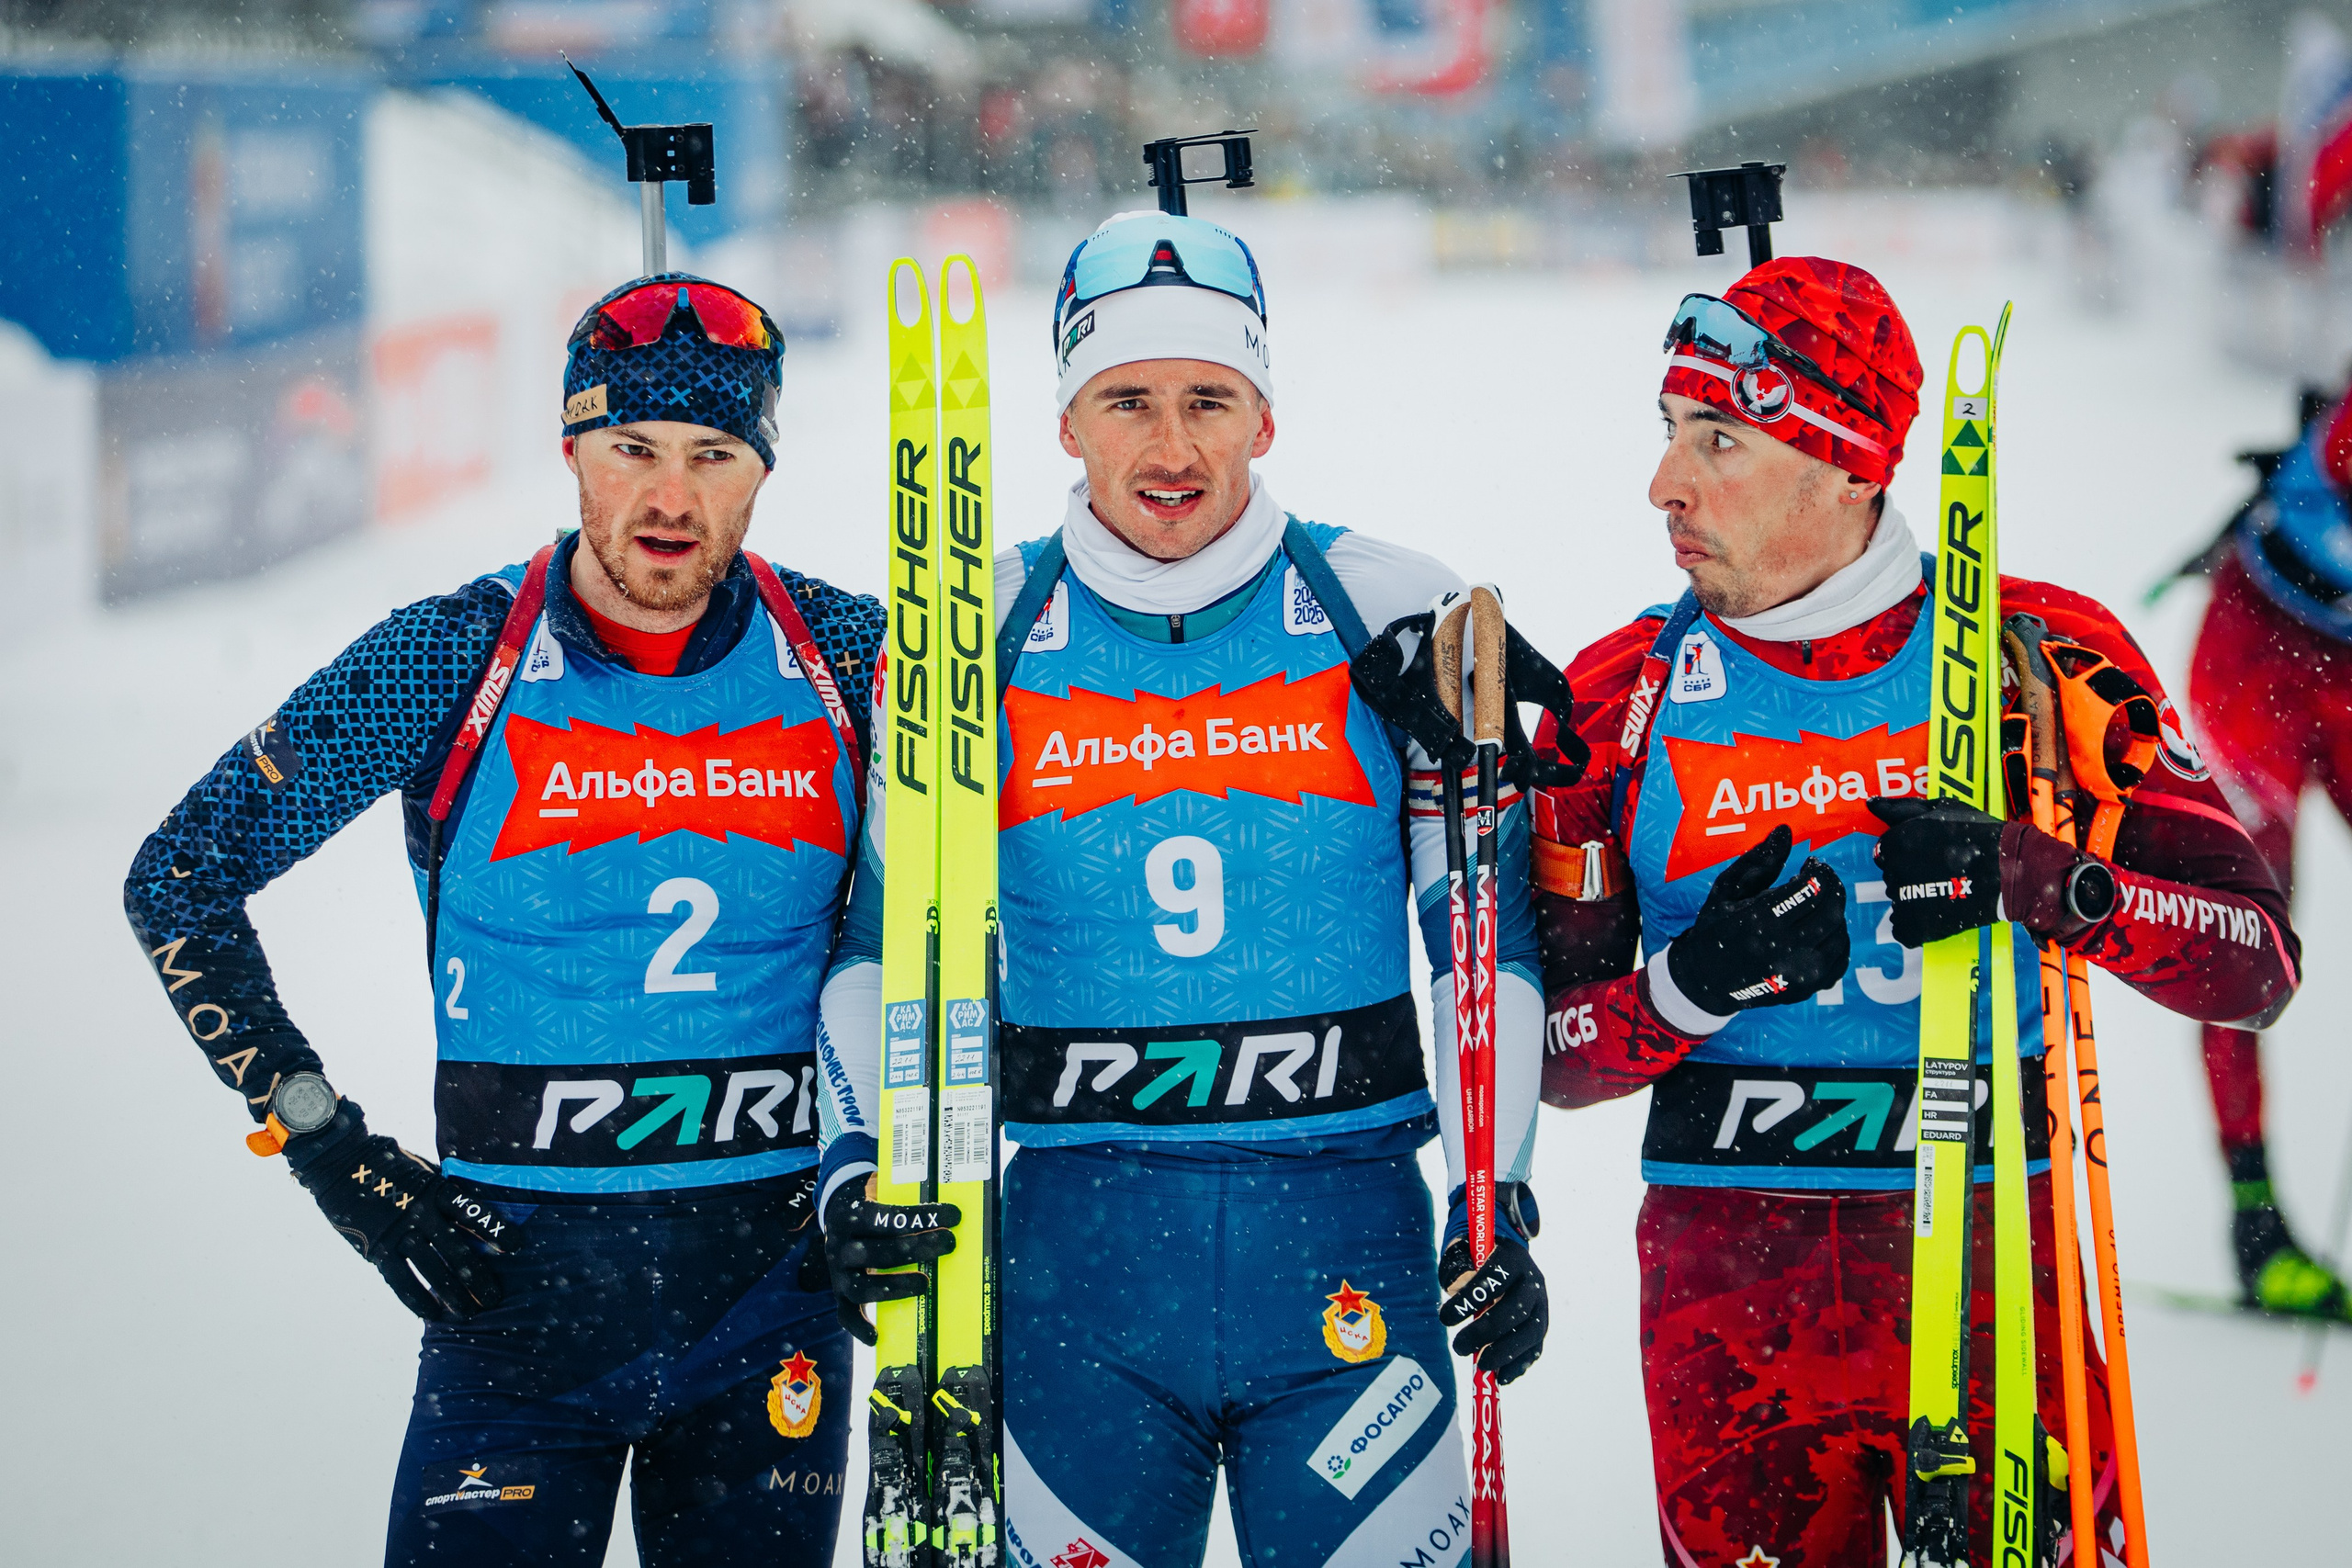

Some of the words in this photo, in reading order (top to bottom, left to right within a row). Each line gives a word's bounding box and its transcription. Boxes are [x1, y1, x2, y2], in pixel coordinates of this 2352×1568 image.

[1962, 402, 1977, 416] 2
[897, 438, 928, 795] FISCHER
[949, 436, 984, 795] FISCHER
[1294, 604, 1325, 625] 2025
[1030, 631, 1054, 642] СБР
[1683, 682, 1711, 693] СБР
[1035, 722, 1194, 772] Альфа
[1206, 717, 1329, 758] Банк
[258, 757, 279, 781] PRO
[541, 759, 696, 808] Альфа
[706, 759, 820, 798] Банк
[1708, 763, 1868, 819] Альфа
[1876, 758, 1928, 798] Ба
[1145, 835, 1225, 958] 9
[2120, 881, 2261, 949] УДМУРТИЯ
[644, 877, 720, 994] 2
[1816, 881, 1923, 1006] 3
[1449, 870, 1474, 1056] MOAX
[1476, 864, 1490, 1051] MOAX
[446, 957, 469, 1021] 2
[900, 1004, 911, 1013] КА
[961, 1002, 974, 1010] КА
[896, 1012, 916, 1023] РИМ
[957, 1010, 978, 1020] РИМ
[961, 1019, 974, 1028] АС
[1546, 1003, 1599, 1055] ПСБ
[816, 1003, 865, 1127] ОМФИНСТРОЙ
[1054, 1025, 1342, 1111] PARI
[1925, 1061, 1968, 1071] LATYPOV
[532, 1066, 815, 1150] PARI
[1713, 1079, 1994, 1151] PAR
[1924, 1090, 1938, 1100] FA
[1924, 1111, 1938, 1120] HR
[1923, 1131, 1962, 1140] EDUARD
[788, 1179, 817, 1208] MO
[1476, 1185, 1486, 1212] STAR
[451, 1195, 505, 1238] MOAX
[875, 1212, 939, 1229] MOAX
[1454, 1264, 1510, 1316] MOAX
[983, 1293, 991, 1336] speedmax
[1340, 1326, 1369, 1342] ЦСКА
[784, 1393, 807, 1415] ЦСКА
[1350, 1373, 1424, 1455] ФОСАГРО
[503, 1488, 532, 1498] PRO
[769, 1468, 843, 1495] MOAX
[1005, 1517, 1043, 1568] ПРО
[1399, 1495, 1471, 1568] MOAX
